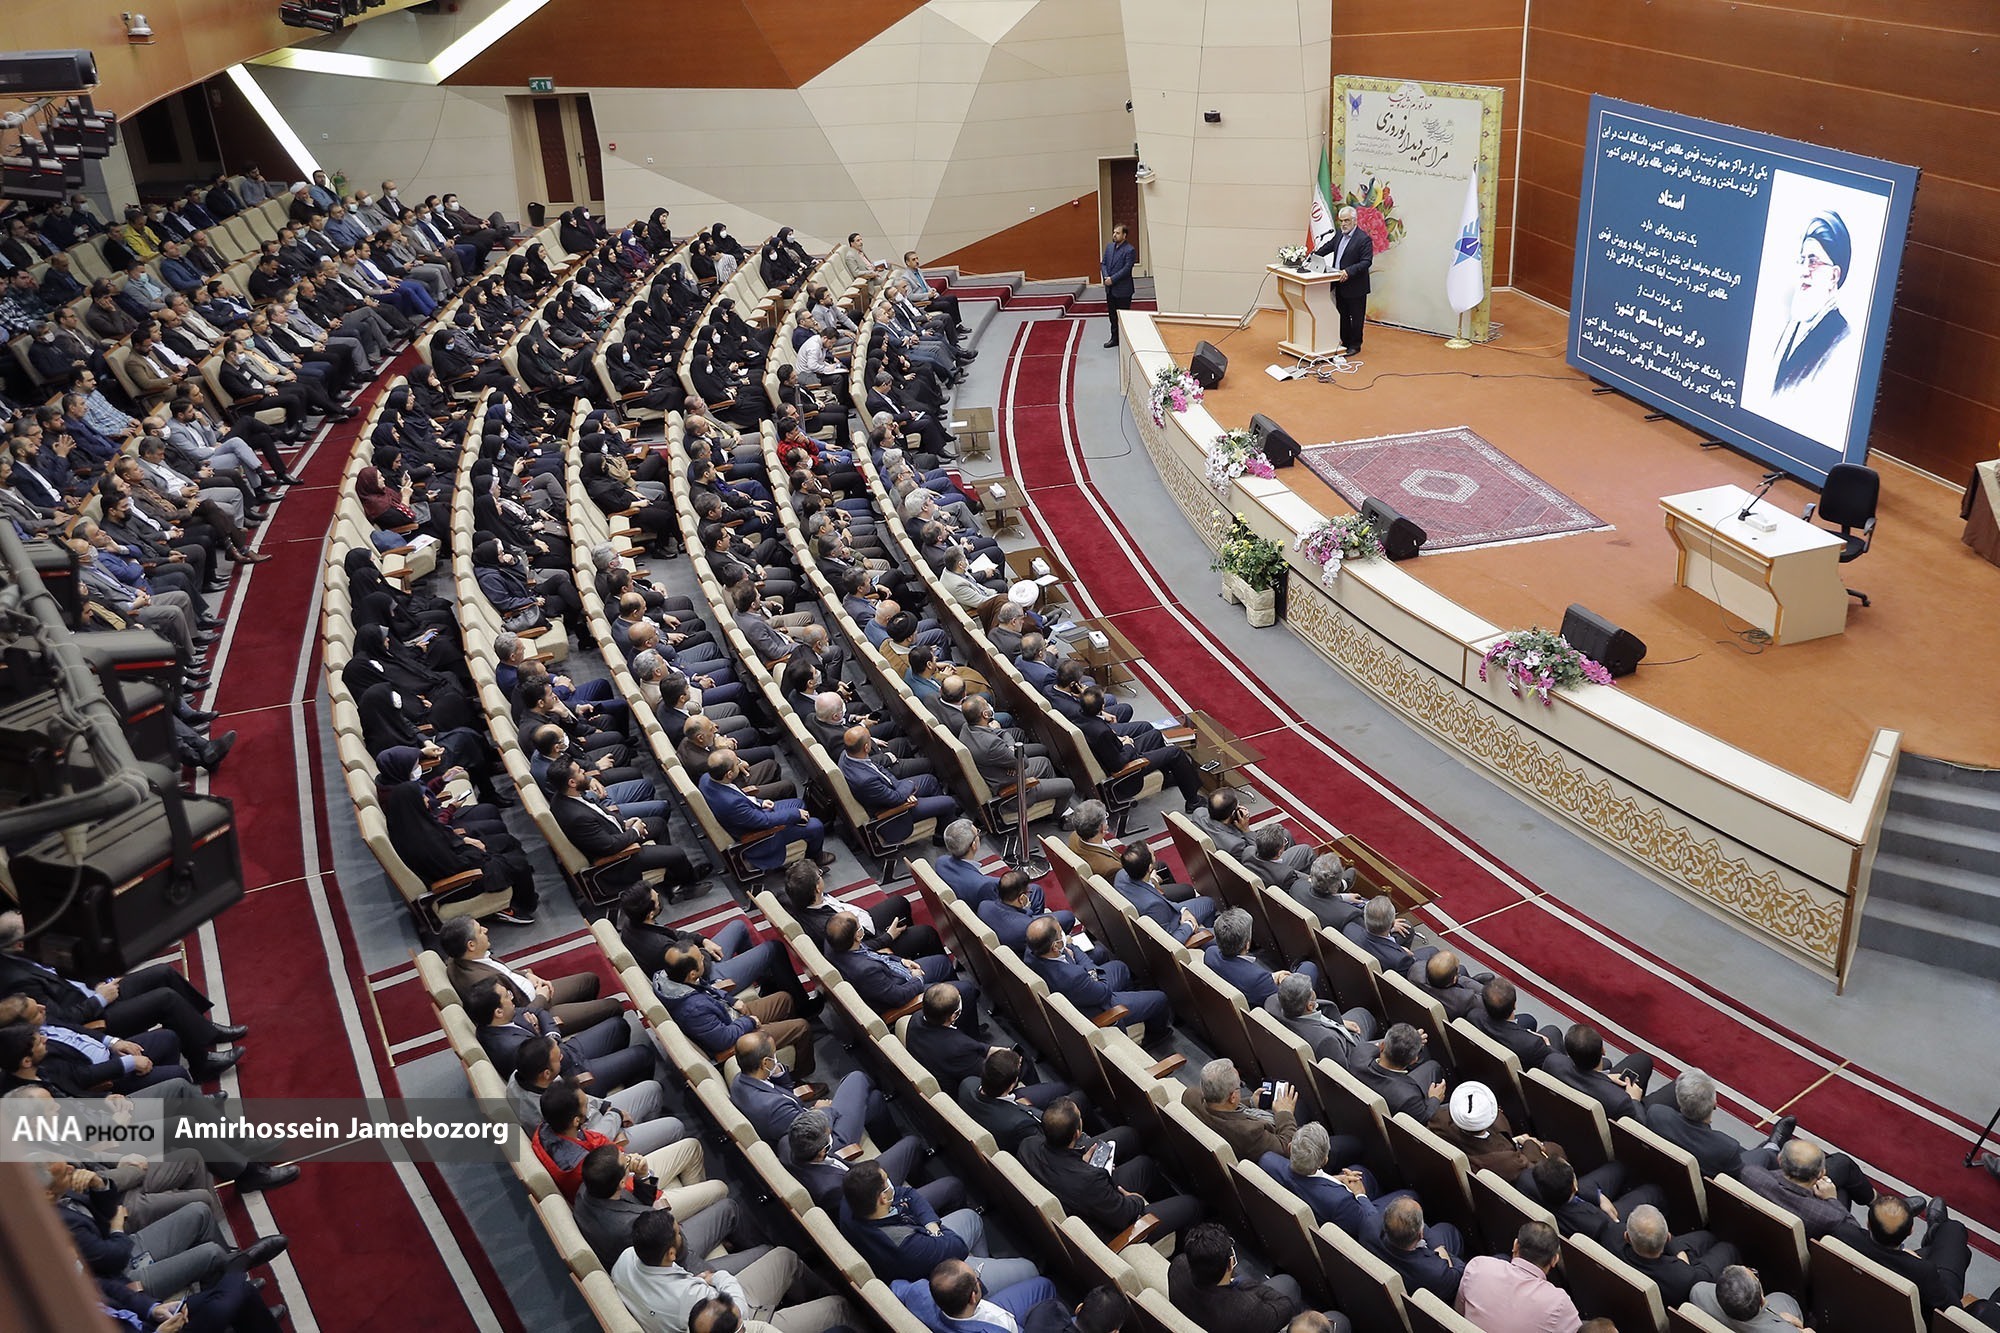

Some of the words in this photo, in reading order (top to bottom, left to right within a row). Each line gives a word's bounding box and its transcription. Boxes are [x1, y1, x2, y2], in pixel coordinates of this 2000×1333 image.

[1376, 112, 1408, 140] نوروزی
[1602, 126, 1611, 138] این
[1611, 131, 1617, 140] در
[1618, 131, 1630, 140] است
[1630, 133, 1648, 145] دانشگاه
[1398, 132, 1423, 162] دیدار
[1417, 146, 1449, 168] مراسم
[1637, 154, 1649, 167] برای
[1650, 157, 1662, 168] عاقله
[1700, 153, 1717, 167] تربیت
[1678, 166, 1691, 178] دادن
[1731, 159, 1747, 174] مراکز
[1748, 163, 1754, 177] از
[1754, 166, 1768, 180] یکی
[1692, 170, 1711, 186] پرورش
[1712, 178, 1717, 187] و
[1717, 178, 1738, 189] ساختن
[1739, 182, 1758, 197] فرایند
[1658, 189, 1685, 210] استاد
[1641, 219, 1653, 232] دارد
[1611, 234, 1627, 249] پرورش
[1673, 231, 1686, 242] نقش
[1687, 234, 1697, 247] یک
[1628, 242, 1632, 250] و
[1633, 240, 1646, 254] ایجاد
[1606, 248, 1616, 260] دارد
[1662, 249, 1666, 263] را
[1667, 255, 1680, 265] نقش
[1634, 259, 1643, 271] یک
[1681, 258, 1691, 270] این
[1691, 262, 1710, 277] بخواهد
[1656, 266, 1666, 279] ایفا
[1666, 272, 1682, 286] درست
[1711, 268, 1732, 282] دانشگاه
[1730, 275, 1741, 287] اگر
[1637, 284, 1643, 296] از
[1643, 289, 1655, 298] است
[1692, 283, 1708, 293] کشور
[1655, 294, 1671, 306] عبارت
[1671, 300, 1682, 312] یکی
[1635, 309, 1656, 326] مسائل
[1599, 320, 1613, 333] مسائل
[1658, 317, 1663, 332] با
[1664, 325, 1682, 336] شدن
[1582, 331, 1593, 343] باشد
[1594, 336, 1606, 346] اصلی
[1630, 332, 1639, 345] جدا
[1639, 341, 1654, 350] کشور
[1653, 344, 1669, 358] مسائل
[1630, 354, 1644, 367] واقعی
[1670, 351, 1676, 363] از
[1676, 352, 1680, 366] را
[1645, 358, 1660, 372] مسائل
[1681, 358, 1700, 372] خودش
[1701, 364, 1721, 380] دانشگاه
[1682, 376, 1695, 390] برای
[1695, 384, 1711, 394] کشور
[1721, 378, 1736, 389] یعنی
